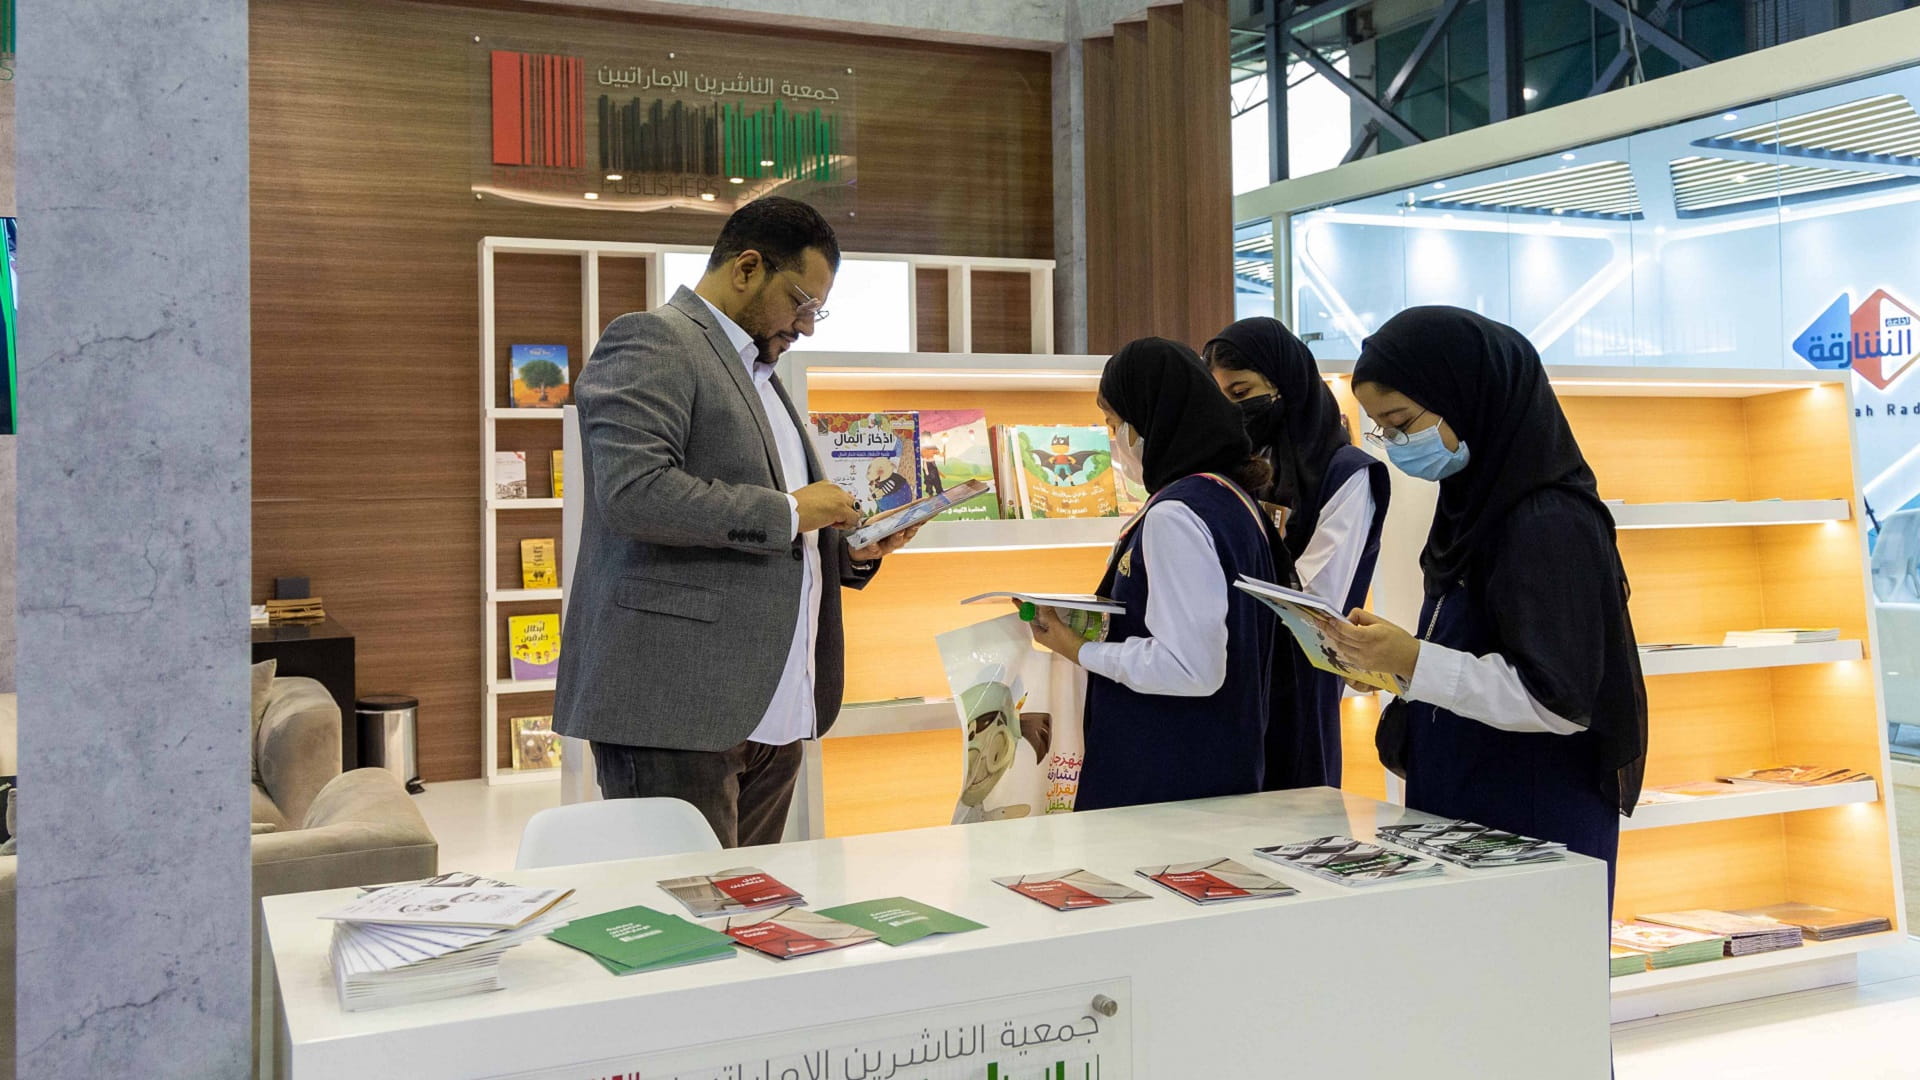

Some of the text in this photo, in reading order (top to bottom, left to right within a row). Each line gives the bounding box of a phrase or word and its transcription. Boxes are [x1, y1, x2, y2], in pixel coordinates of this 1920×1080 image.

[598, 65, 839, 104] جمعية الناشرين الإماراتيين
[601, 174, 721, 198] PUBLISHERS
[845, 1024, 985, 1080] الناشرين
[1001, 1016, 1099, 1056] جمعية
